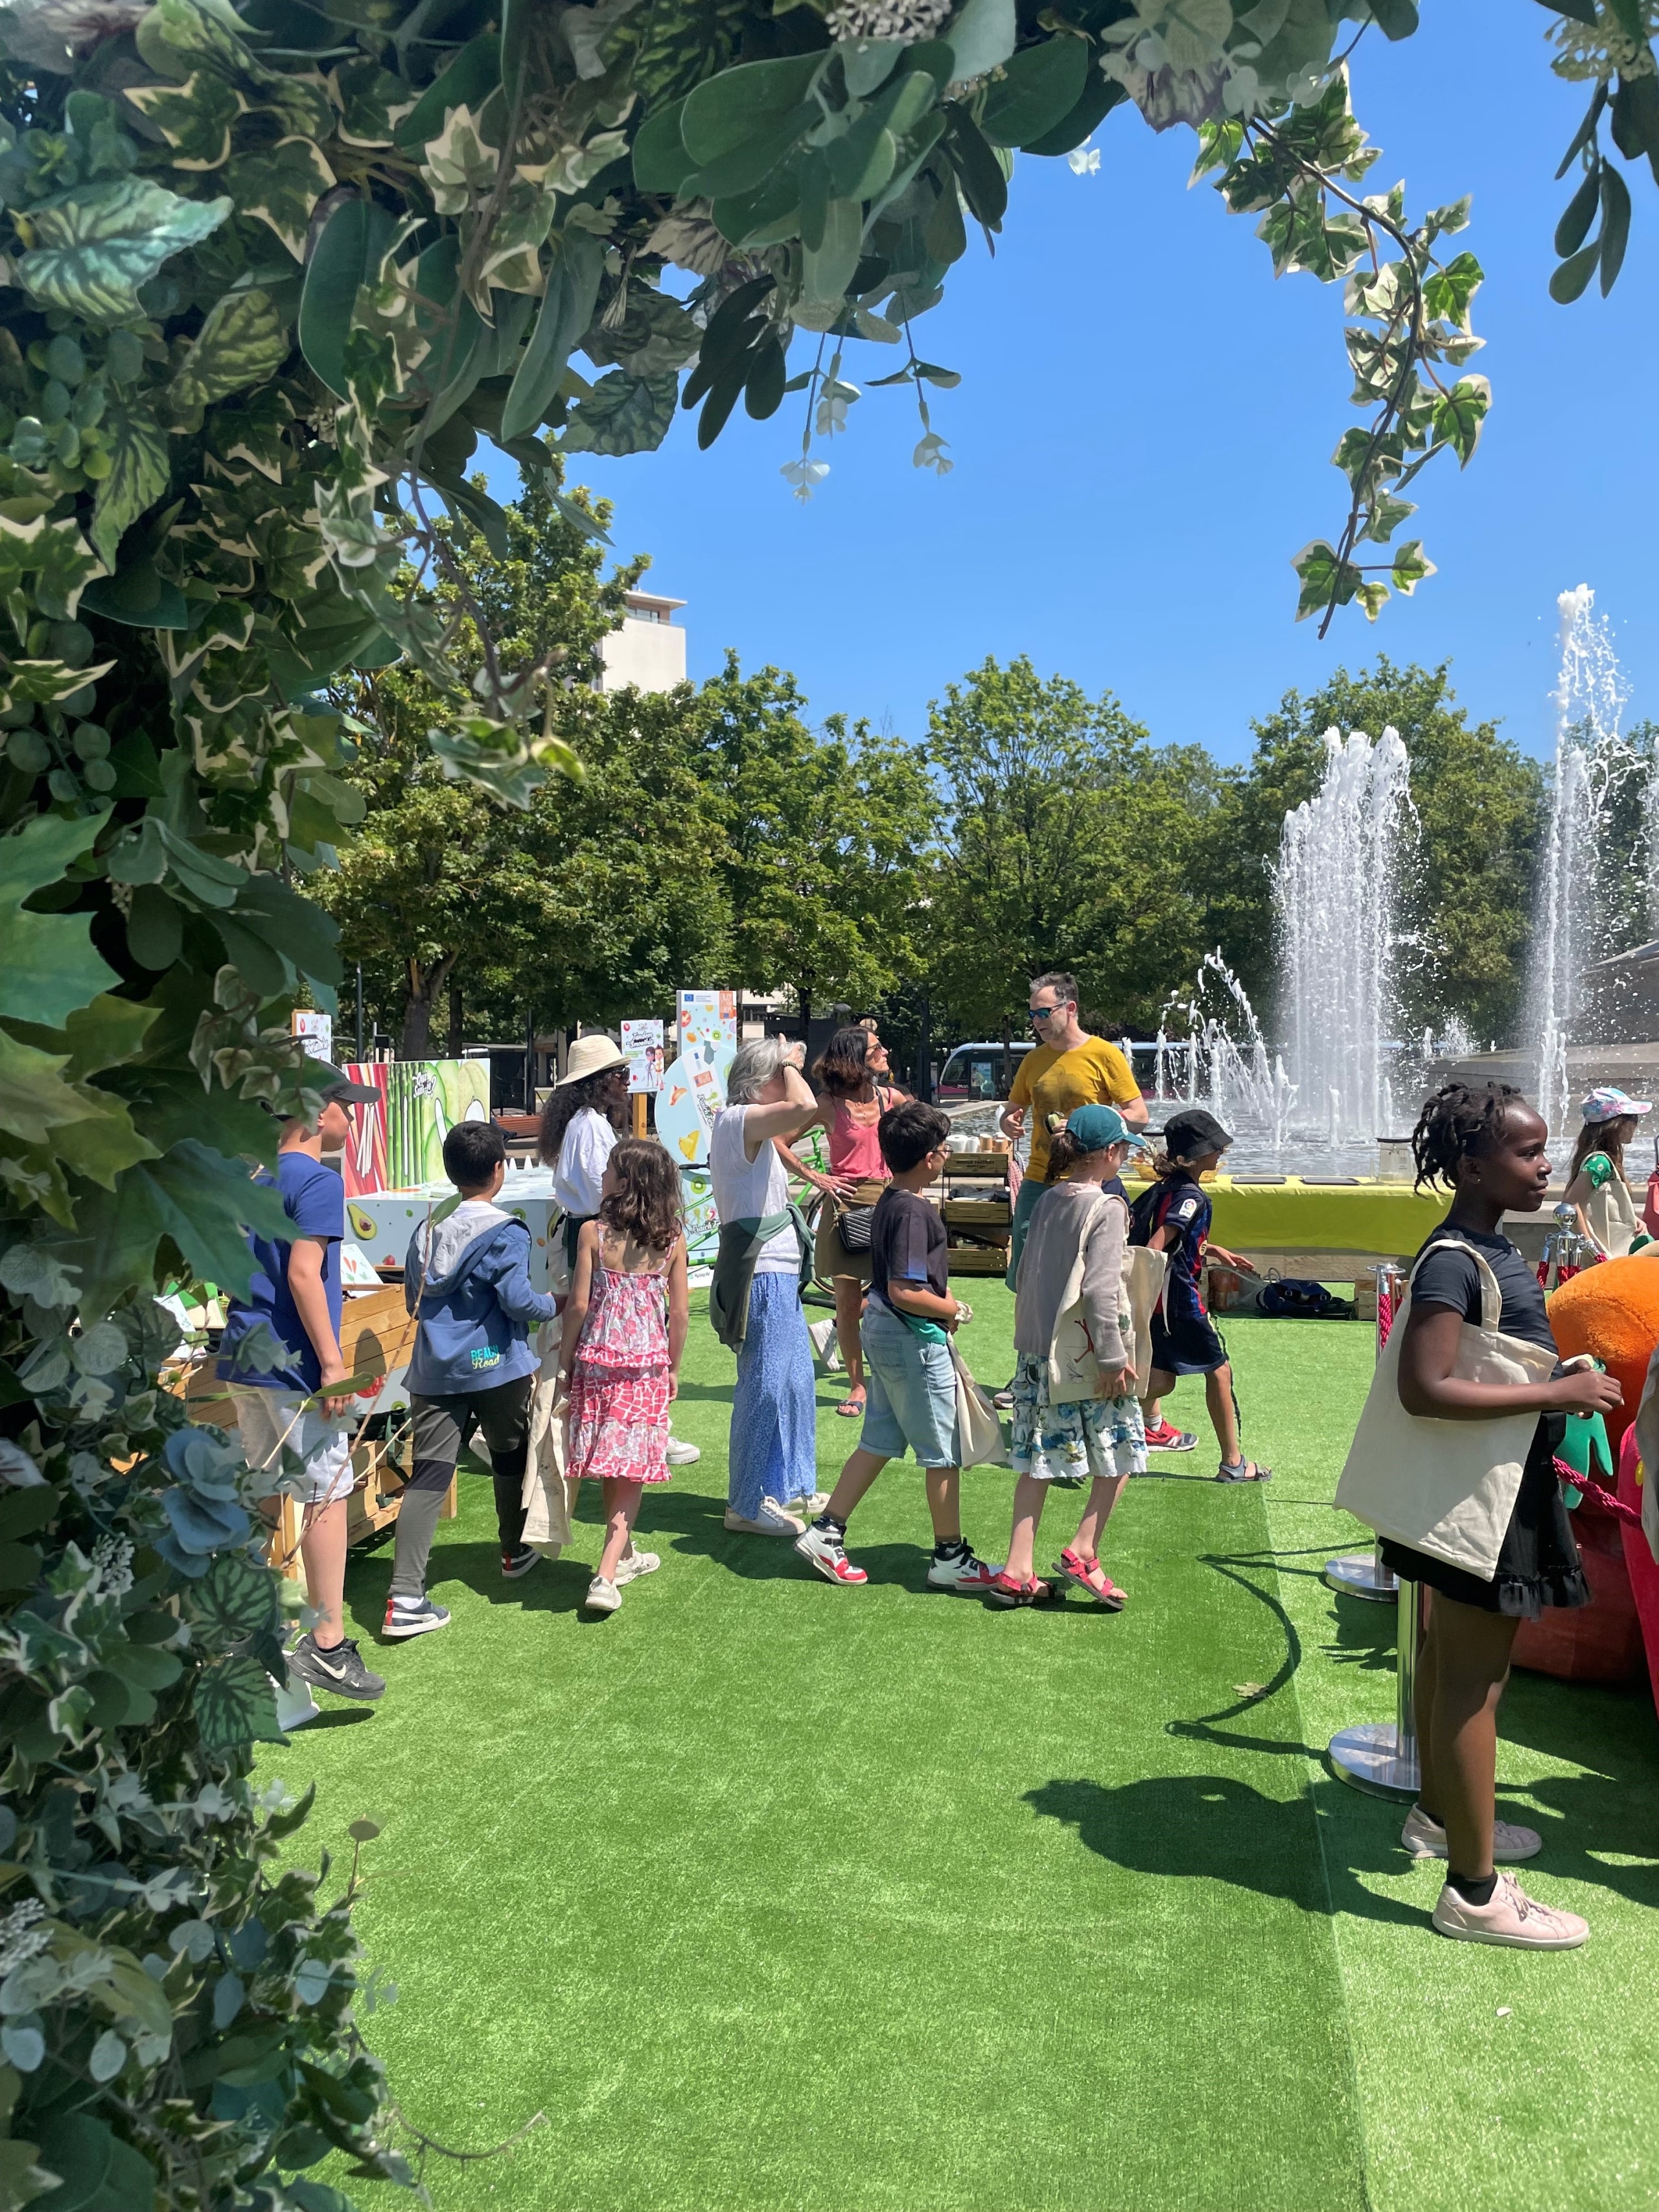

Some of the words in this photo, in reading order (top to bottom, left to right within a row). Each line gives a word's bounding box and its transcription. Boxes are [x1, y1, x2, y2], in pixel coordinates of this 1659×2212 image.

[632, 1031, 653, 1041] Tandem
[629, 1038, 654, 1048] Smoothie
[470, 1345, 499, 1360] BEACH
[471, 1352, 500, 1369] Road
